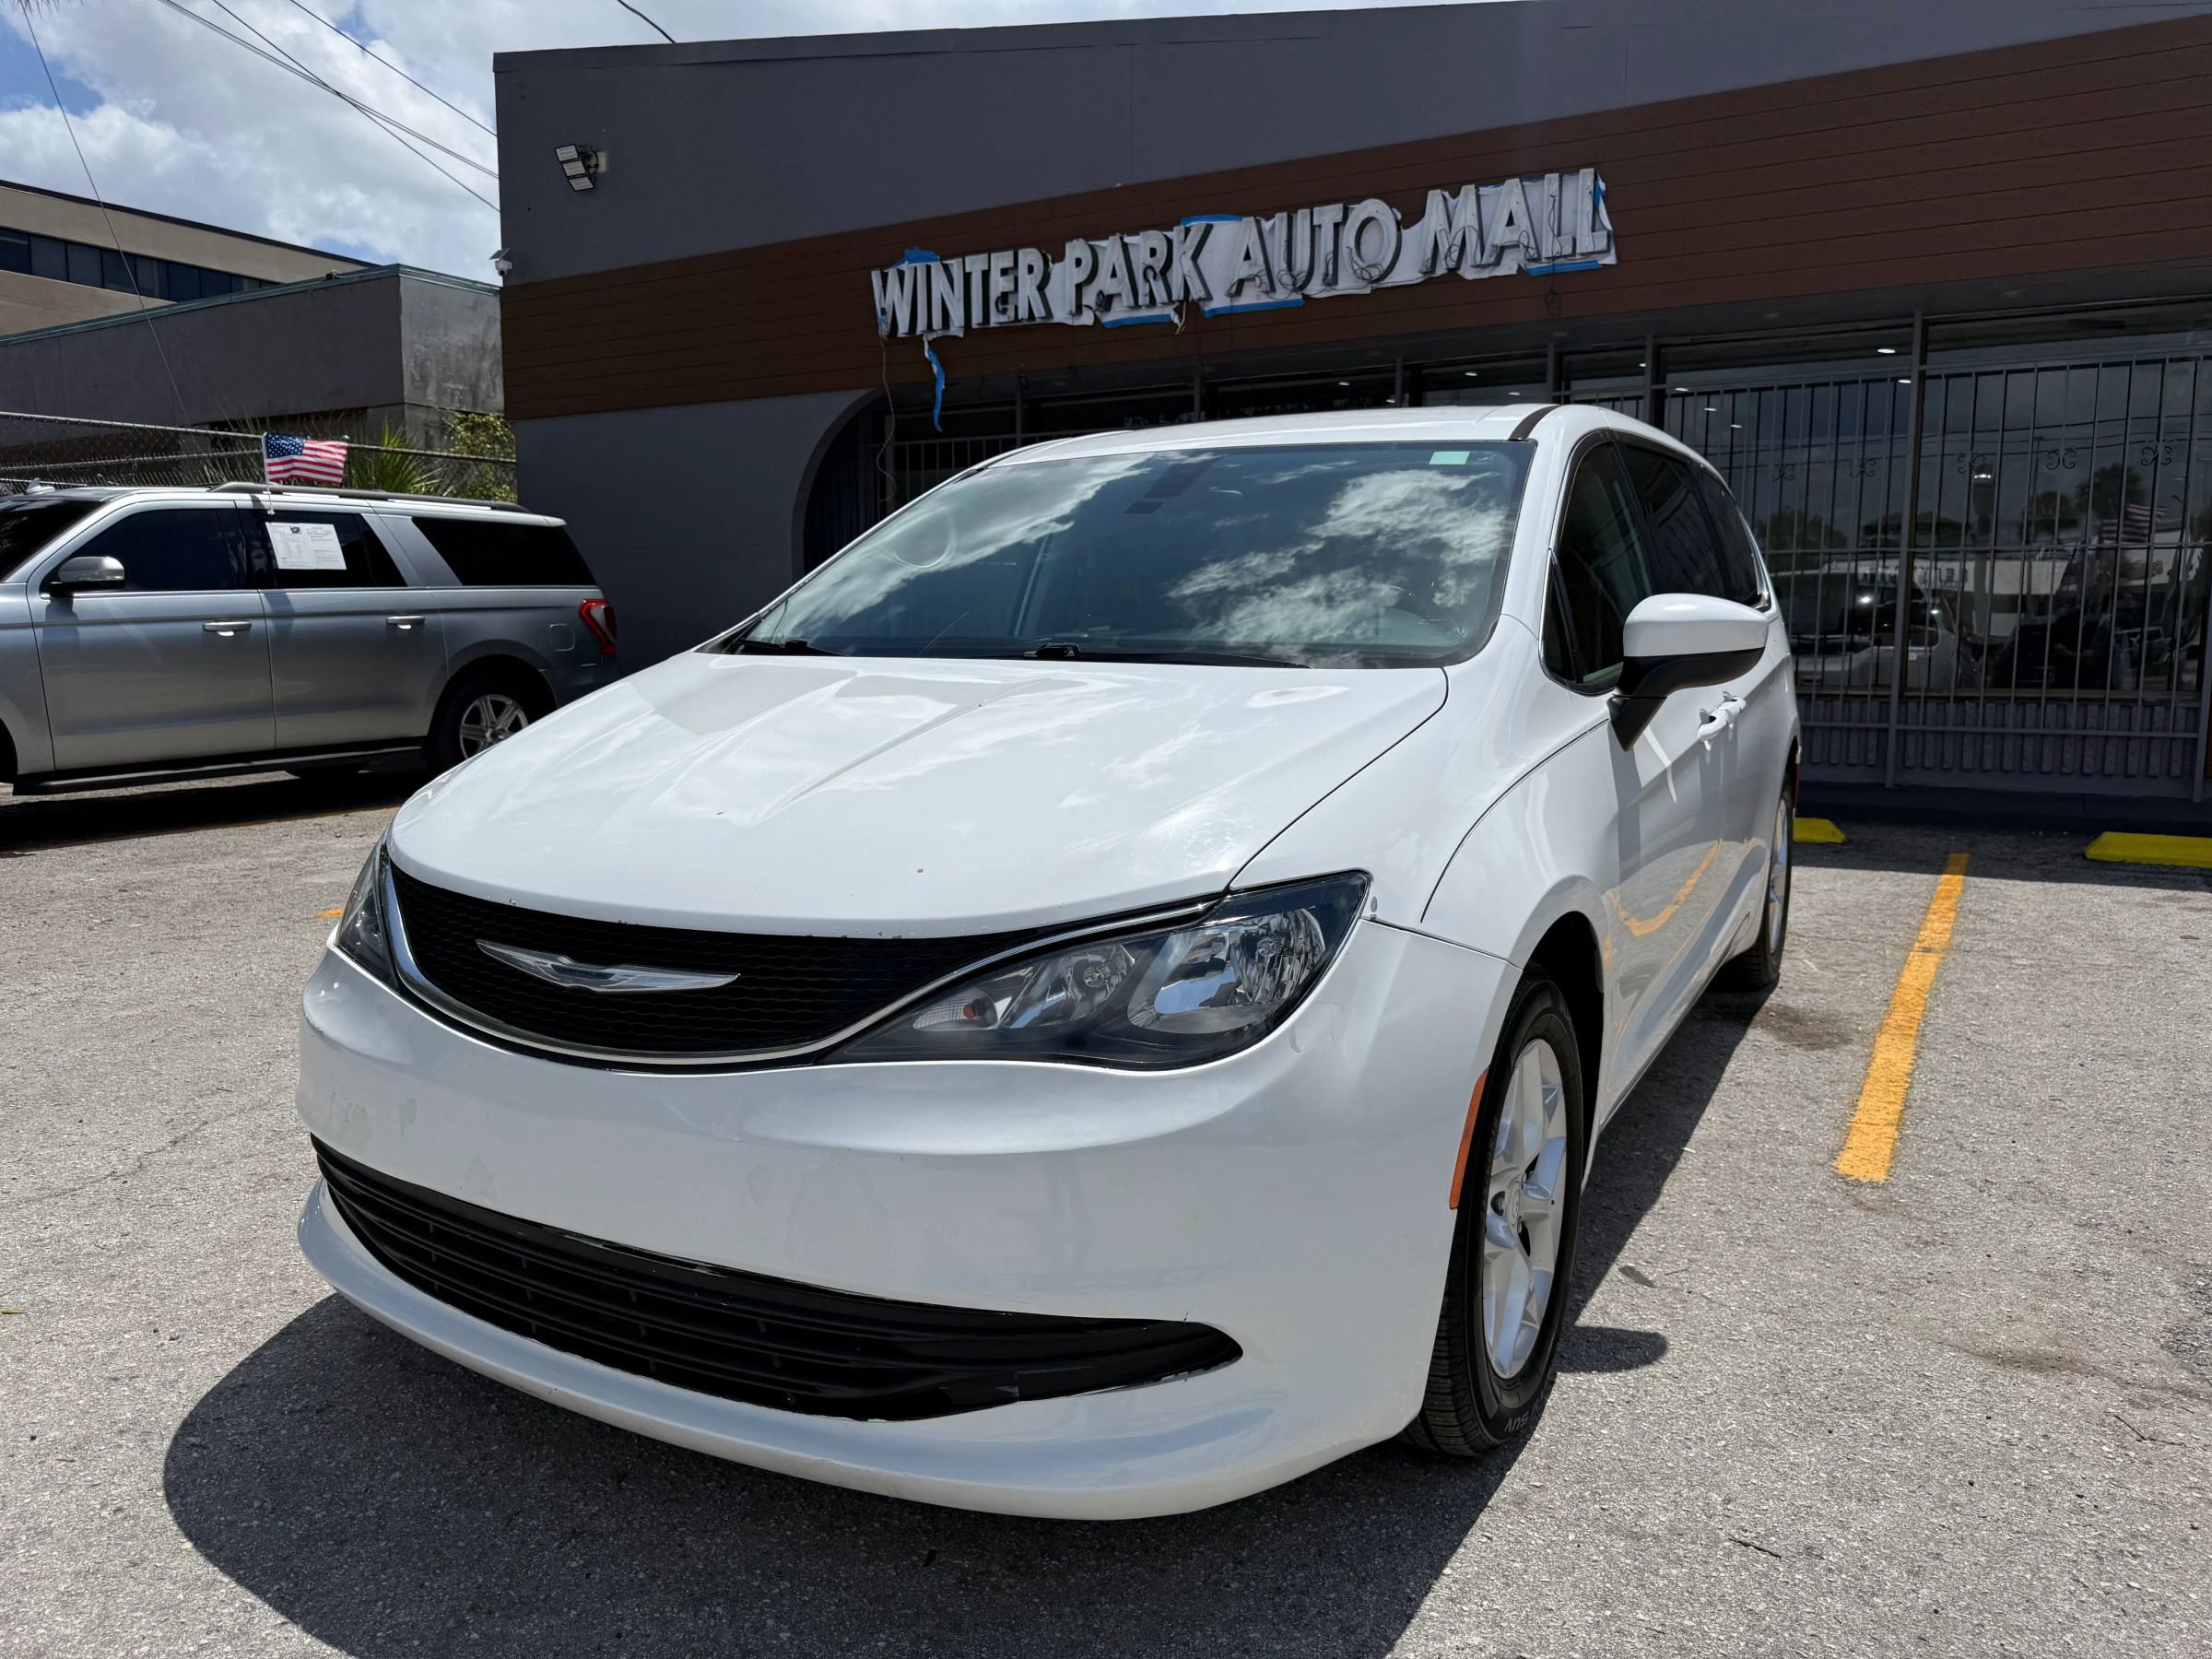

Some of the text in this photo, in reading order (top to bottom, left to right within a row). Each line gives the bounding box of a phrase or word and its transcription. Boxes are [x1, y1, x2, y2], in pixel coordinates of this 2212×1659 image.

[871, 168, 1610, 335] WINTER PARK AUTO MALL
[1505, 1412, 1528, 1432] SUV
